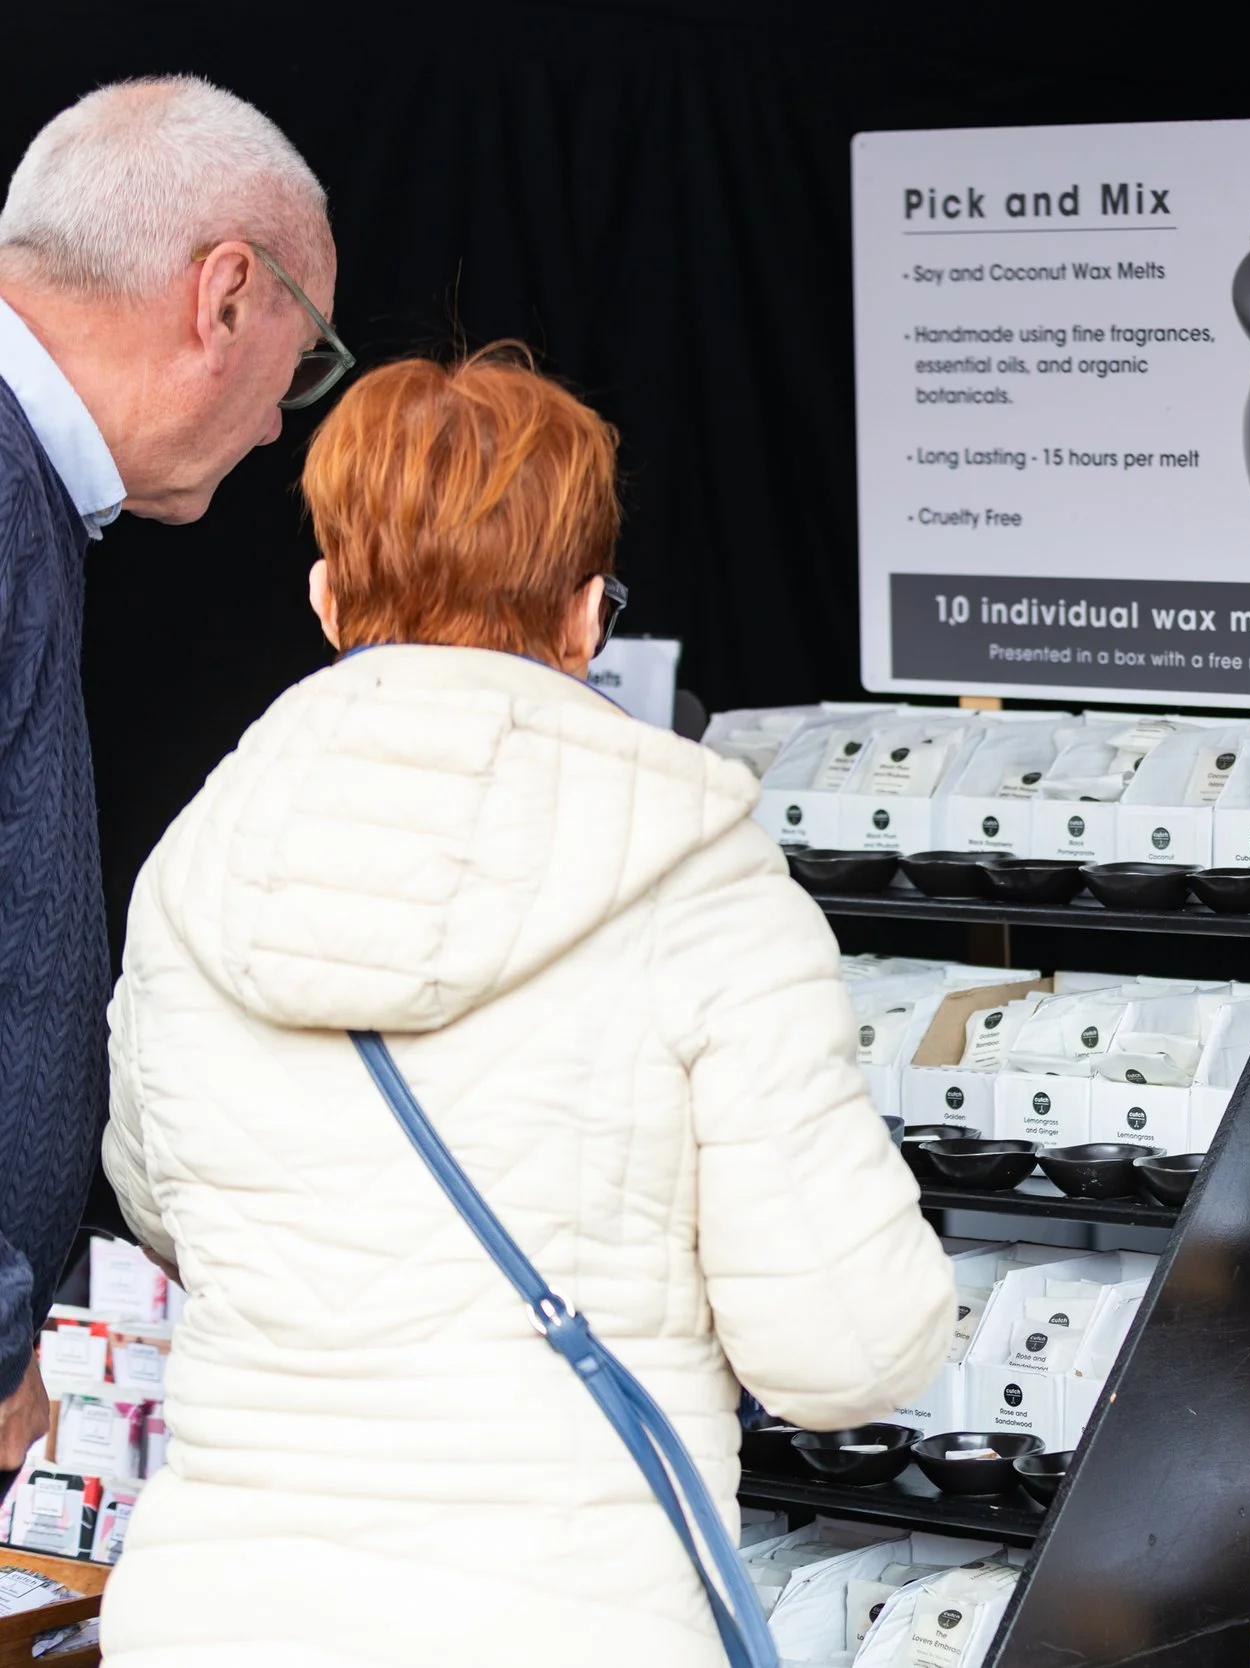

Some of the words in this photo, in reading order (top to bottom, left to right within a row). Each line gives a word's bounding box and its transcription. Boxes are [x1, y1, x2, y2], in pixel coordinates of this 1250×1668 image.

[904, 187, 986, 219] Pick
[1005, 184, 1080, 218] and
[1100, 182, 1172, 215] Mix
[913, 264, 944, 285] Soy
[949, 264, 984, 281] and
[989, 263, 1067, 281] Coconut
[1072, 262, 1112, 280] Wax
[1117, 261, 1166, 280] Melts
[914, 326, 1014, 343] Handmade
[1019, 326, 1067, 347] using
[1072, 325, 1105, 343] fine
[1110, 324, 1216, 347] fragrances,
[915, 356, 992, 374] essential
[997, 356, 1030, 375] oils,
[1036, 356, 1073, 374] and
[1078, 355, 1149, 378] organic
[916, 387, 1014, 405] botanicals.
[917, 448, 959, 469] Long
[965, 448, 1026, 470] Lasting
[1043, 448, 1064, 466] 15
[1068, 448, 1118, 467] hours
[1123, 451, 1154, 470] per
[1159, 450, 1200, 467] melt
[918, 507, 980, 529] Cruelty
[985, 508, 1022, 526] Free
[935, 595, 970, 625] 10
[980, 596, 1139, 629] individual
[1151, 608, 1217, 631] wax
[989, 643, 1072, 664] Presented
[1077, 647, 1092, 664] in
[1097, 651, 1109, 665] a
[1114, 649, 1146, 666] box
[1150, 650, 1186, 667] with
[1191, 655, 1203, 668] a
[1208, 651, 1243, 669] free
[1148, 853, 1175, 861] Coconut
[944, 1113, 966, 1121] Golden
[1023, 1117, 1059, 1127] Lemongrass
[1026, 1127, 1038, 1135] and
[1039, 1128, 1059, 1136] Ginger
[1117, 1131, 1154, 1141] Lemongrass
[954, 1331, 970, 1341] Spice
[1015, 1352, 1032, 1362] Rose
[1033, 1353, 1046, 1363] and
[915, 1409, 932, 1418] Spice
[999, 1408, 1014, 1417] Rose
[1015, 1409, 1028, 1418] and
[995, 1417, 1033, 1429] Sandalwood
[10, 1573, 39, 1586] cutch
[857, 1633, 865, 1641] Lo
[935, 1630, 948, 1639] The
[912, 1634, 934, 1648] Lovers
